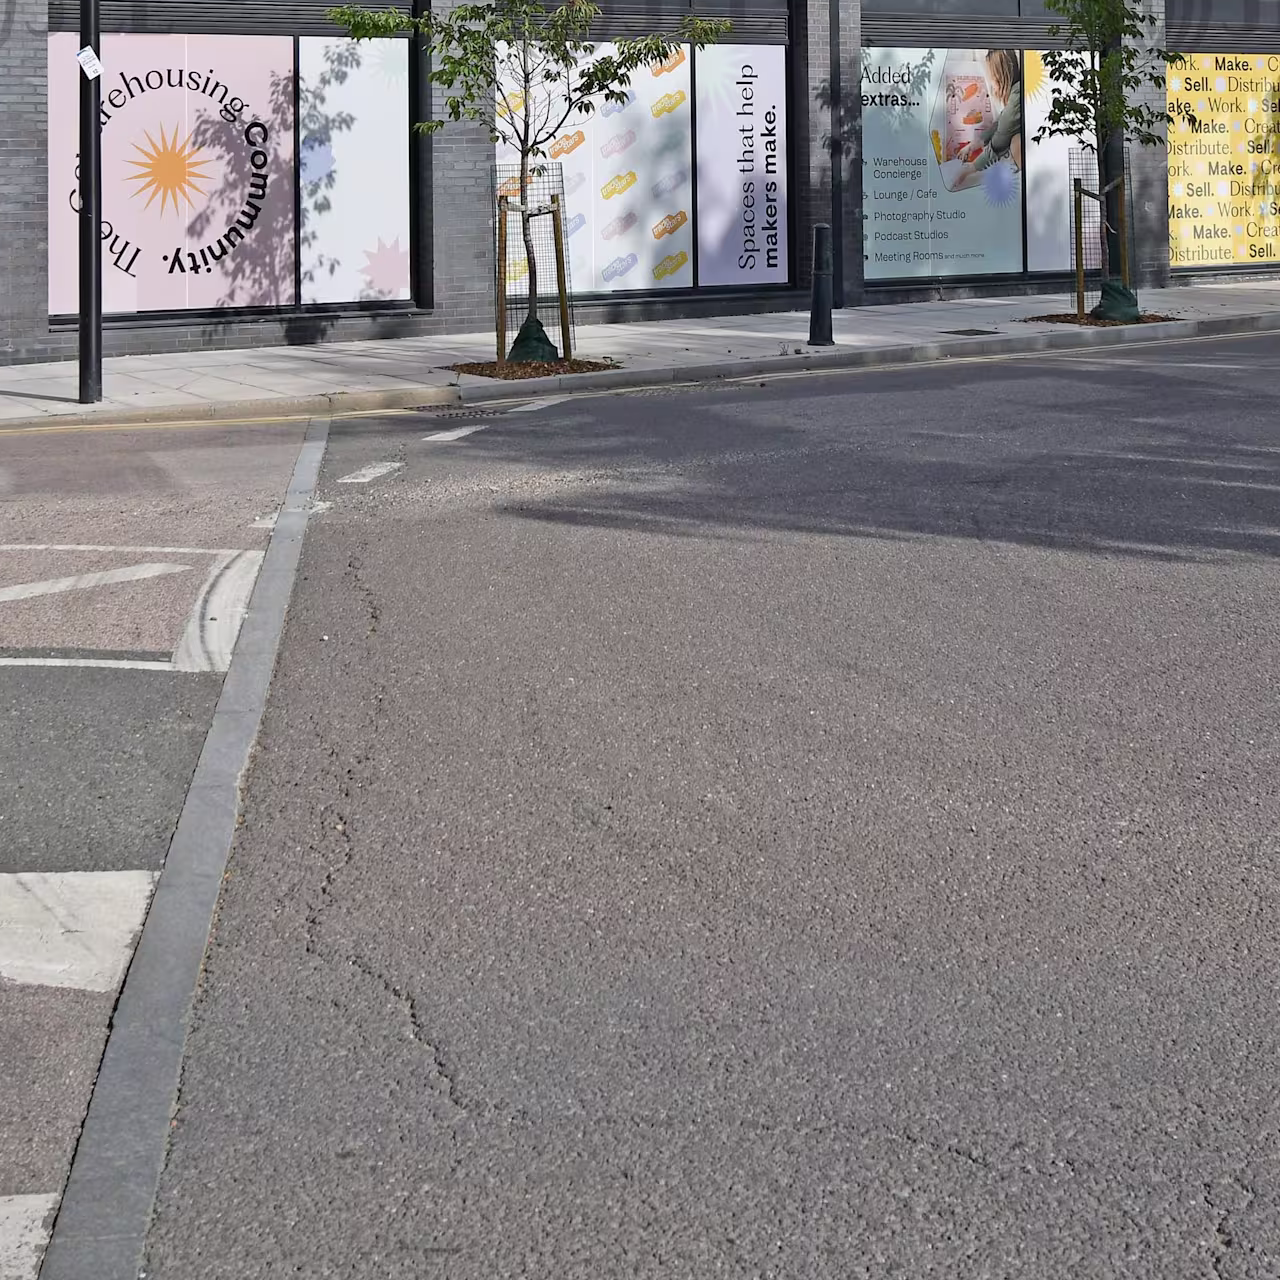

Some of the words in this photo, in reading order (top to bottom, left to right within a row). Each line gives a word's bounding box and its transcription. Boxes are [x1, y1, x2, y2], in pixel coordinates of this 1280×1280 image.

[1215, 56, 1252, 71] Make.
[860, 65, 910, 83] Added
[736, 64, 758, 116] help
[1184, 77, 1212, 92] Sell.
[861, 92, 919, 107] extras...
[1208, 97, 1246, 113] Work.
[1191, 119, 1229, 134] Make.
[760, 105, 777, 175] make.
[1247, 140, 1275, 154] Sell.
[737, 124, 754, 175] that
[873, 157, 927, 167] Warehouse
[1208, 161, 1247, 176] Make.
[873, 170, 922, 180] Concierge
[873, 190, 908, 201] Lounge
[910, 189, 914, 200] /
[916, 189, 938, 199] Cafe
[1186, 182, 1214, 197] Sell.
[101, 221, 142, 278] The
[163, 122, 268, 275] Community.
[874, 211, 934, 222] Photography
[936, 210, 966, 220] Studio
[1217, 201, 1255, 218] Work.
[738, 181, 760, 270] Spaces
[761, 181, 778, 268] makers
[1193, 224, 1231, 240] Make.
[874, 231, 912, 241] Podcast
[914, 230, 948, 240] Studios
[874, 253, 911, 263] Meeting
[913, 252, 943, 261] Rooms
[1249, 243, 1276, 258] Sell.
